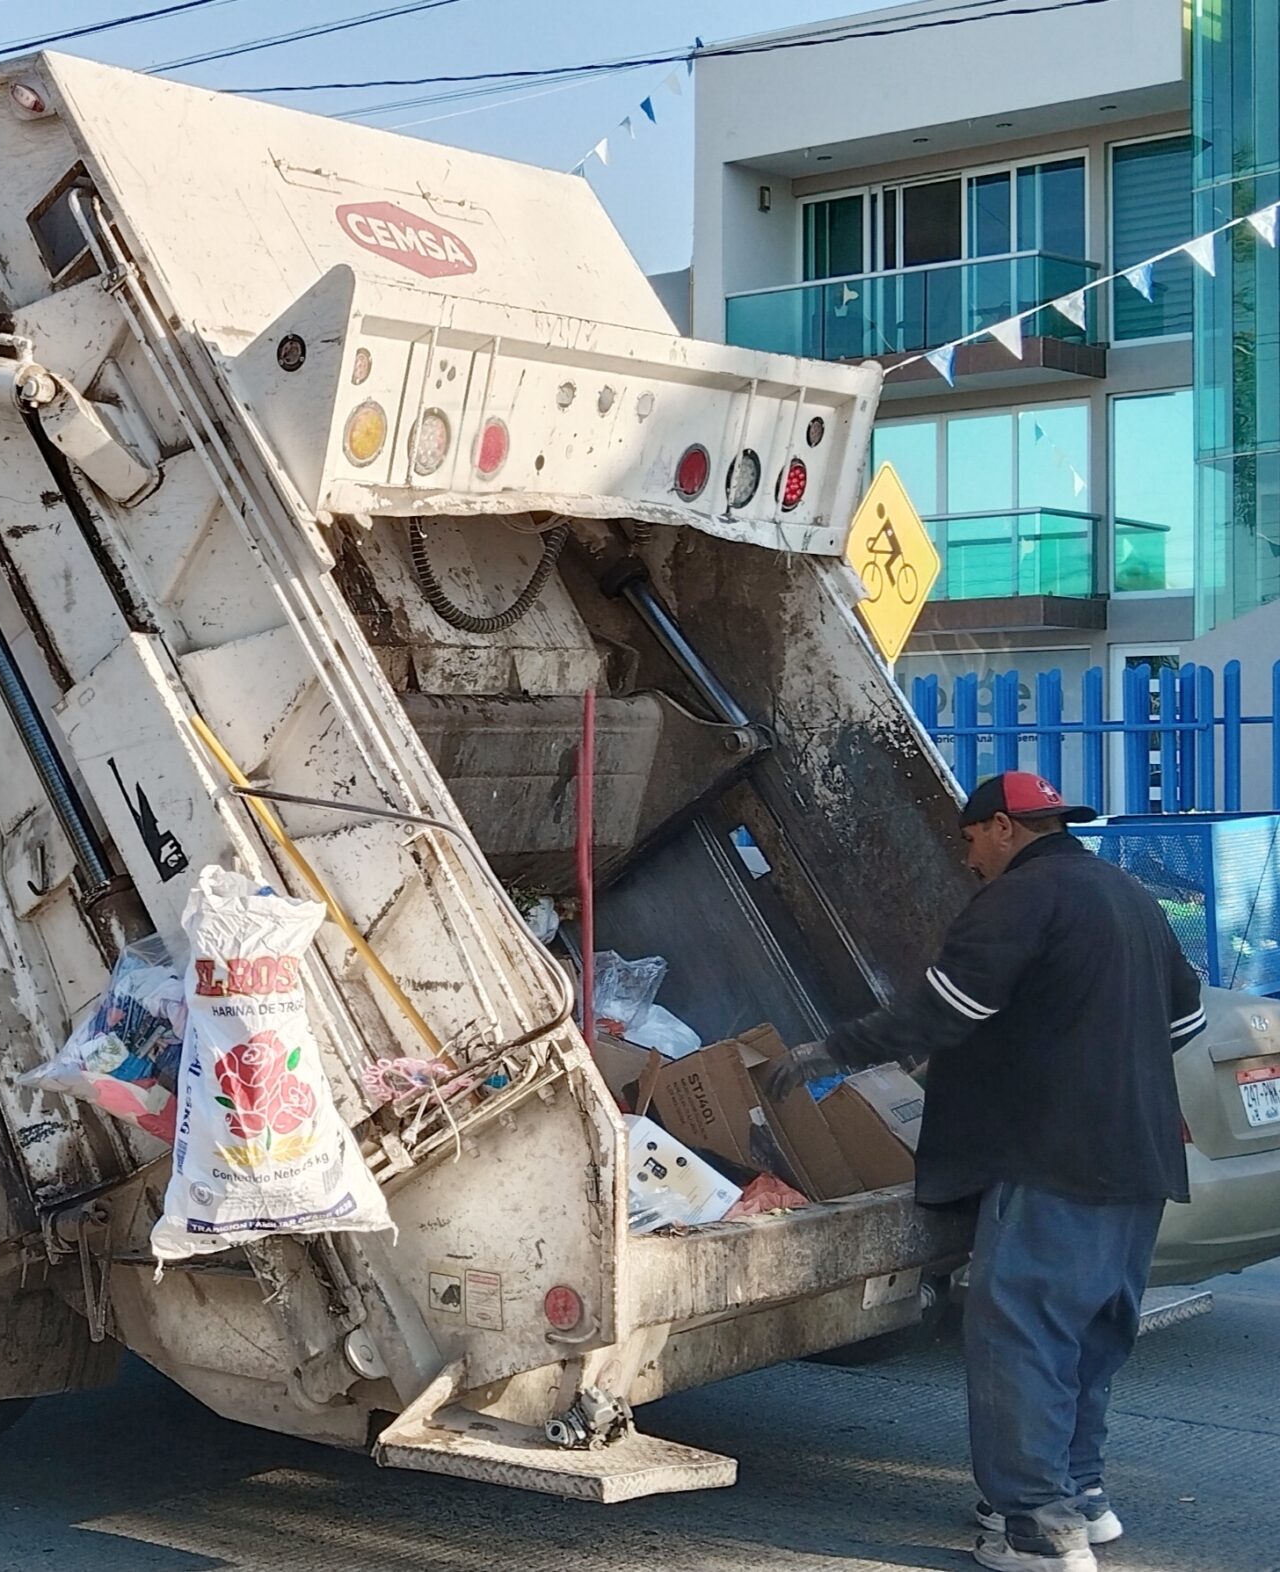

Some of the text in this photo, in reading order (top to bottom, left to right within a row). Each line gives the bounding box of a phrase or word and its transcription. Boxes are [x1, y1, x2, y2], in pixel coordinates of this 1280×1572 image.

[347, 212, 473, 267] CEMSA
[212, 1005, 255, 1018] HARINA
[258, 1002, 276, 1015] DE
[687, 1072, 716, 1125] STJ401
[274, 1167, 302, 1180] Neto
[315, 1152, 330, 1167] kg
